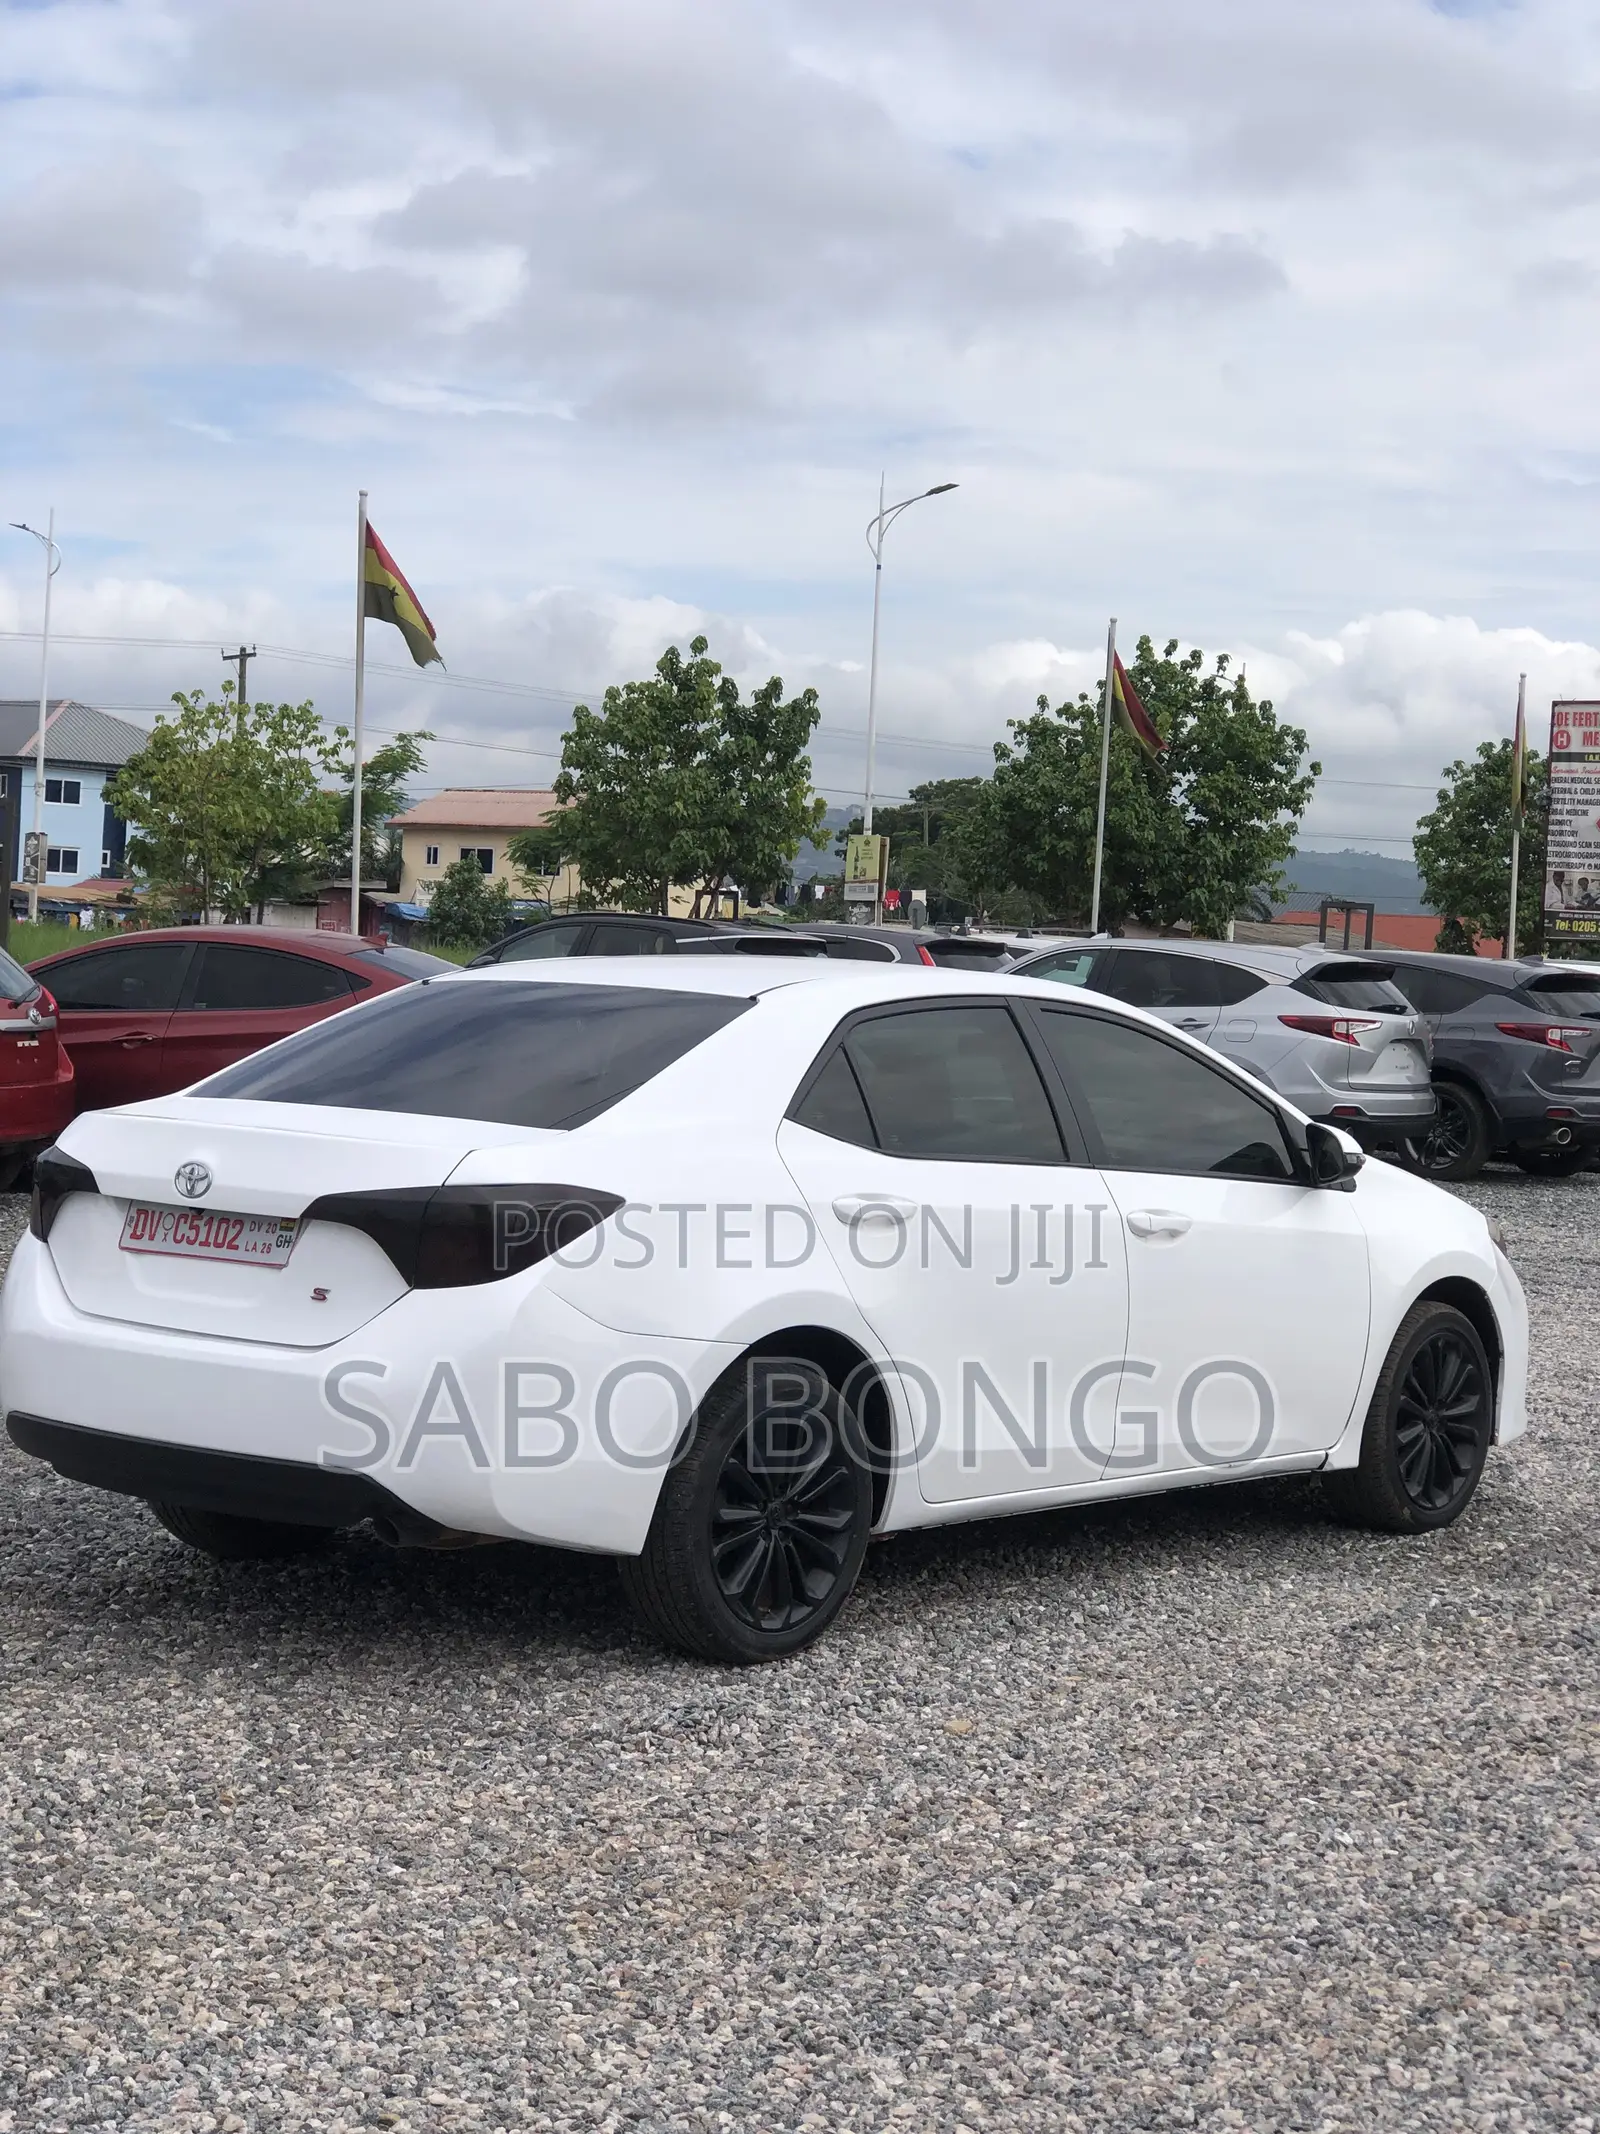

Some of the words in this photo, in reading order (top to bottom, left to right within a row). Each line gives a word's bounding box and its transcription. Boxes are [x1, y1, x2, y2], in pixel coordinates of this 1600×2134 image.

[130, 1208, 163, 1241] DV
[173, 1213, 245, 1251] C5102
[276, 1233, 293, 1249] GH
